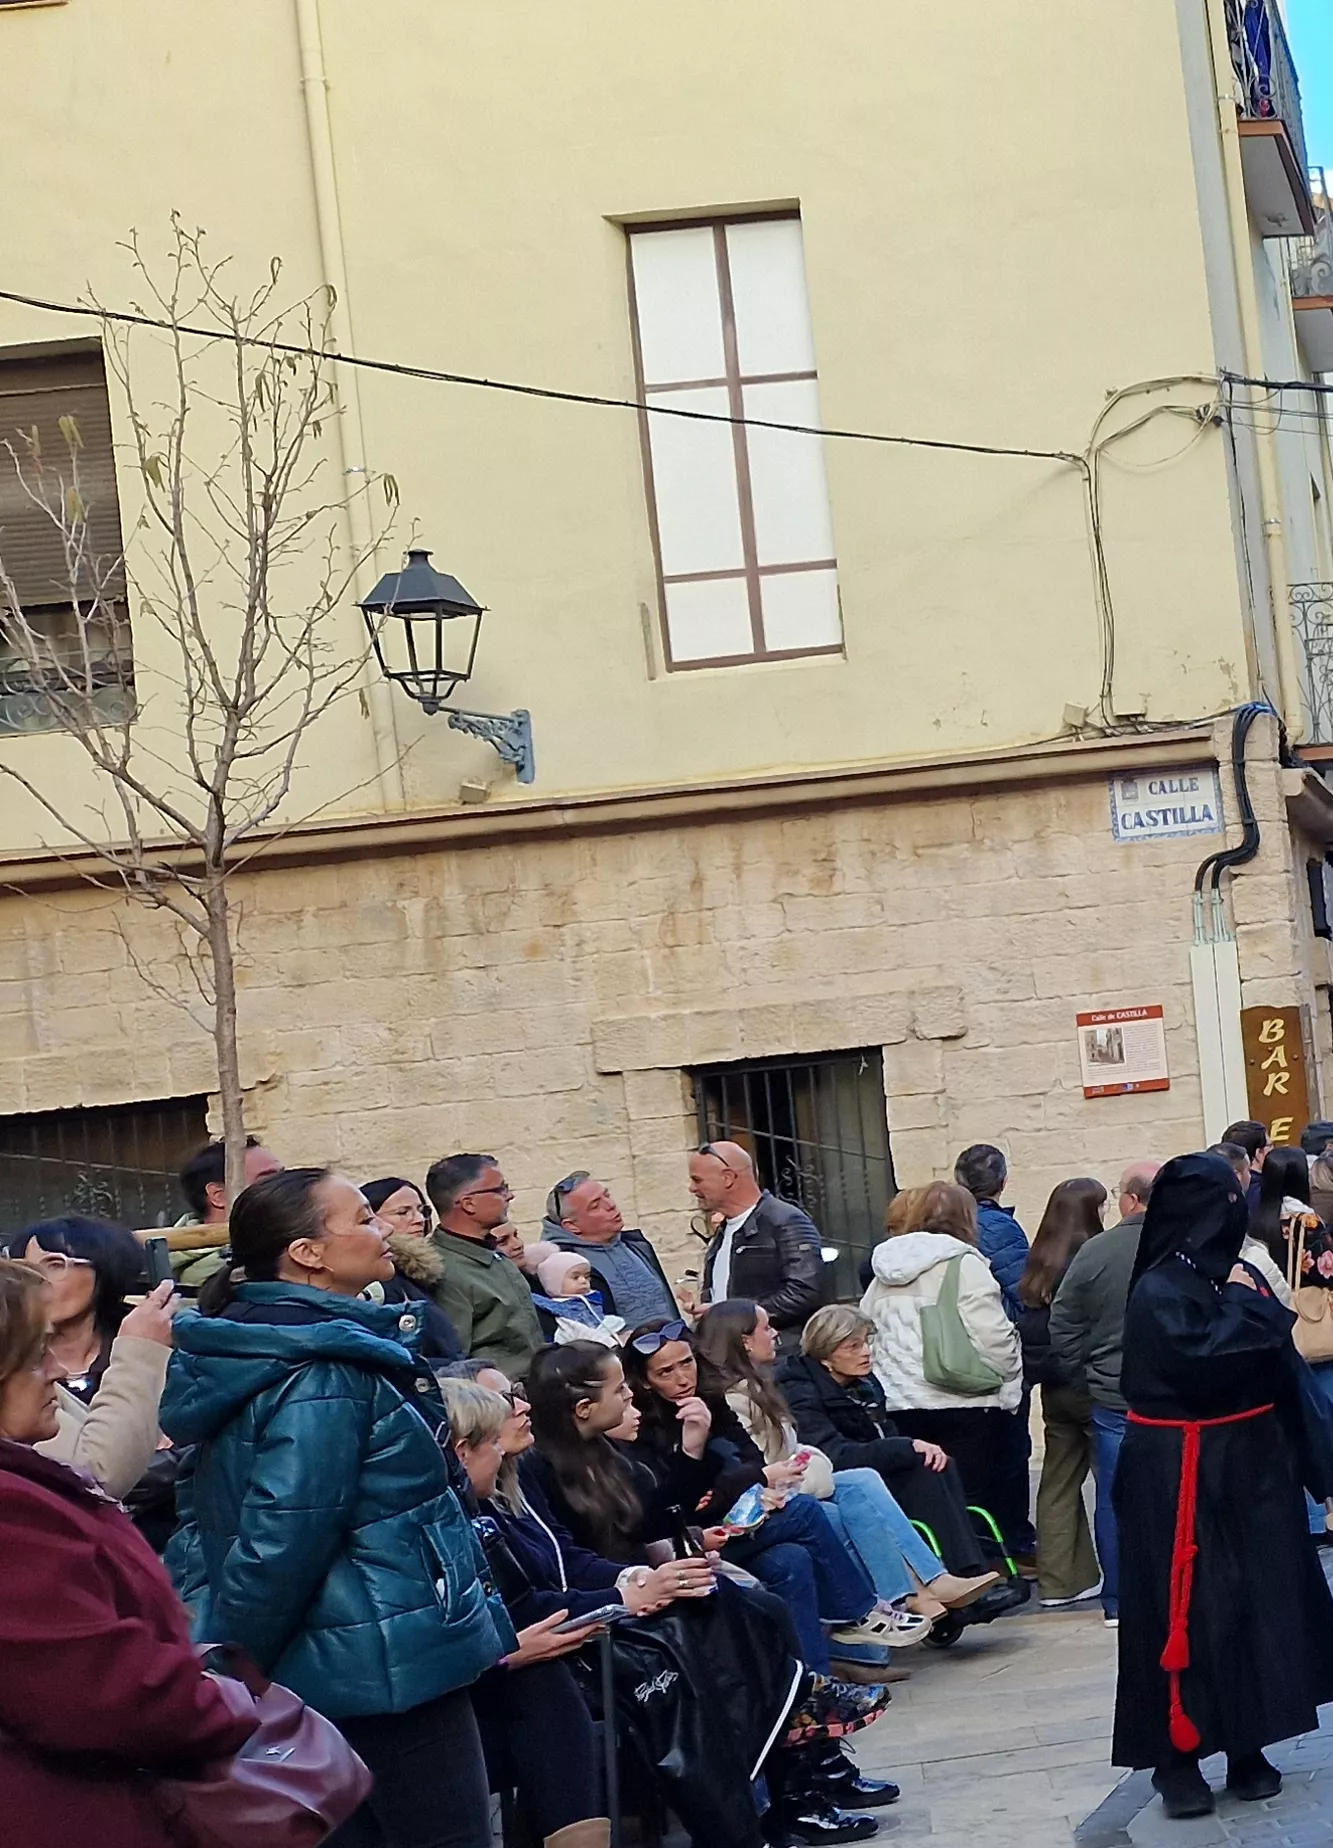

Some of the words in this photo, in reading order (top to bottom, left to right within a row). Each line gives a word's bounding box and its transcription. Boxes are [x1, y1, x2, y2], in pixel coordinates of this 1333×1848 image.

[1148, 777, 1199, 795] CALLE
[1121, 804, 1214, 830] CASTILLA
[1116, 1008, 1148, 1019] CASTILLA
[1258, 1018, 1290, 1096] BAR
[1269, 1116, 1294, 1147] E
